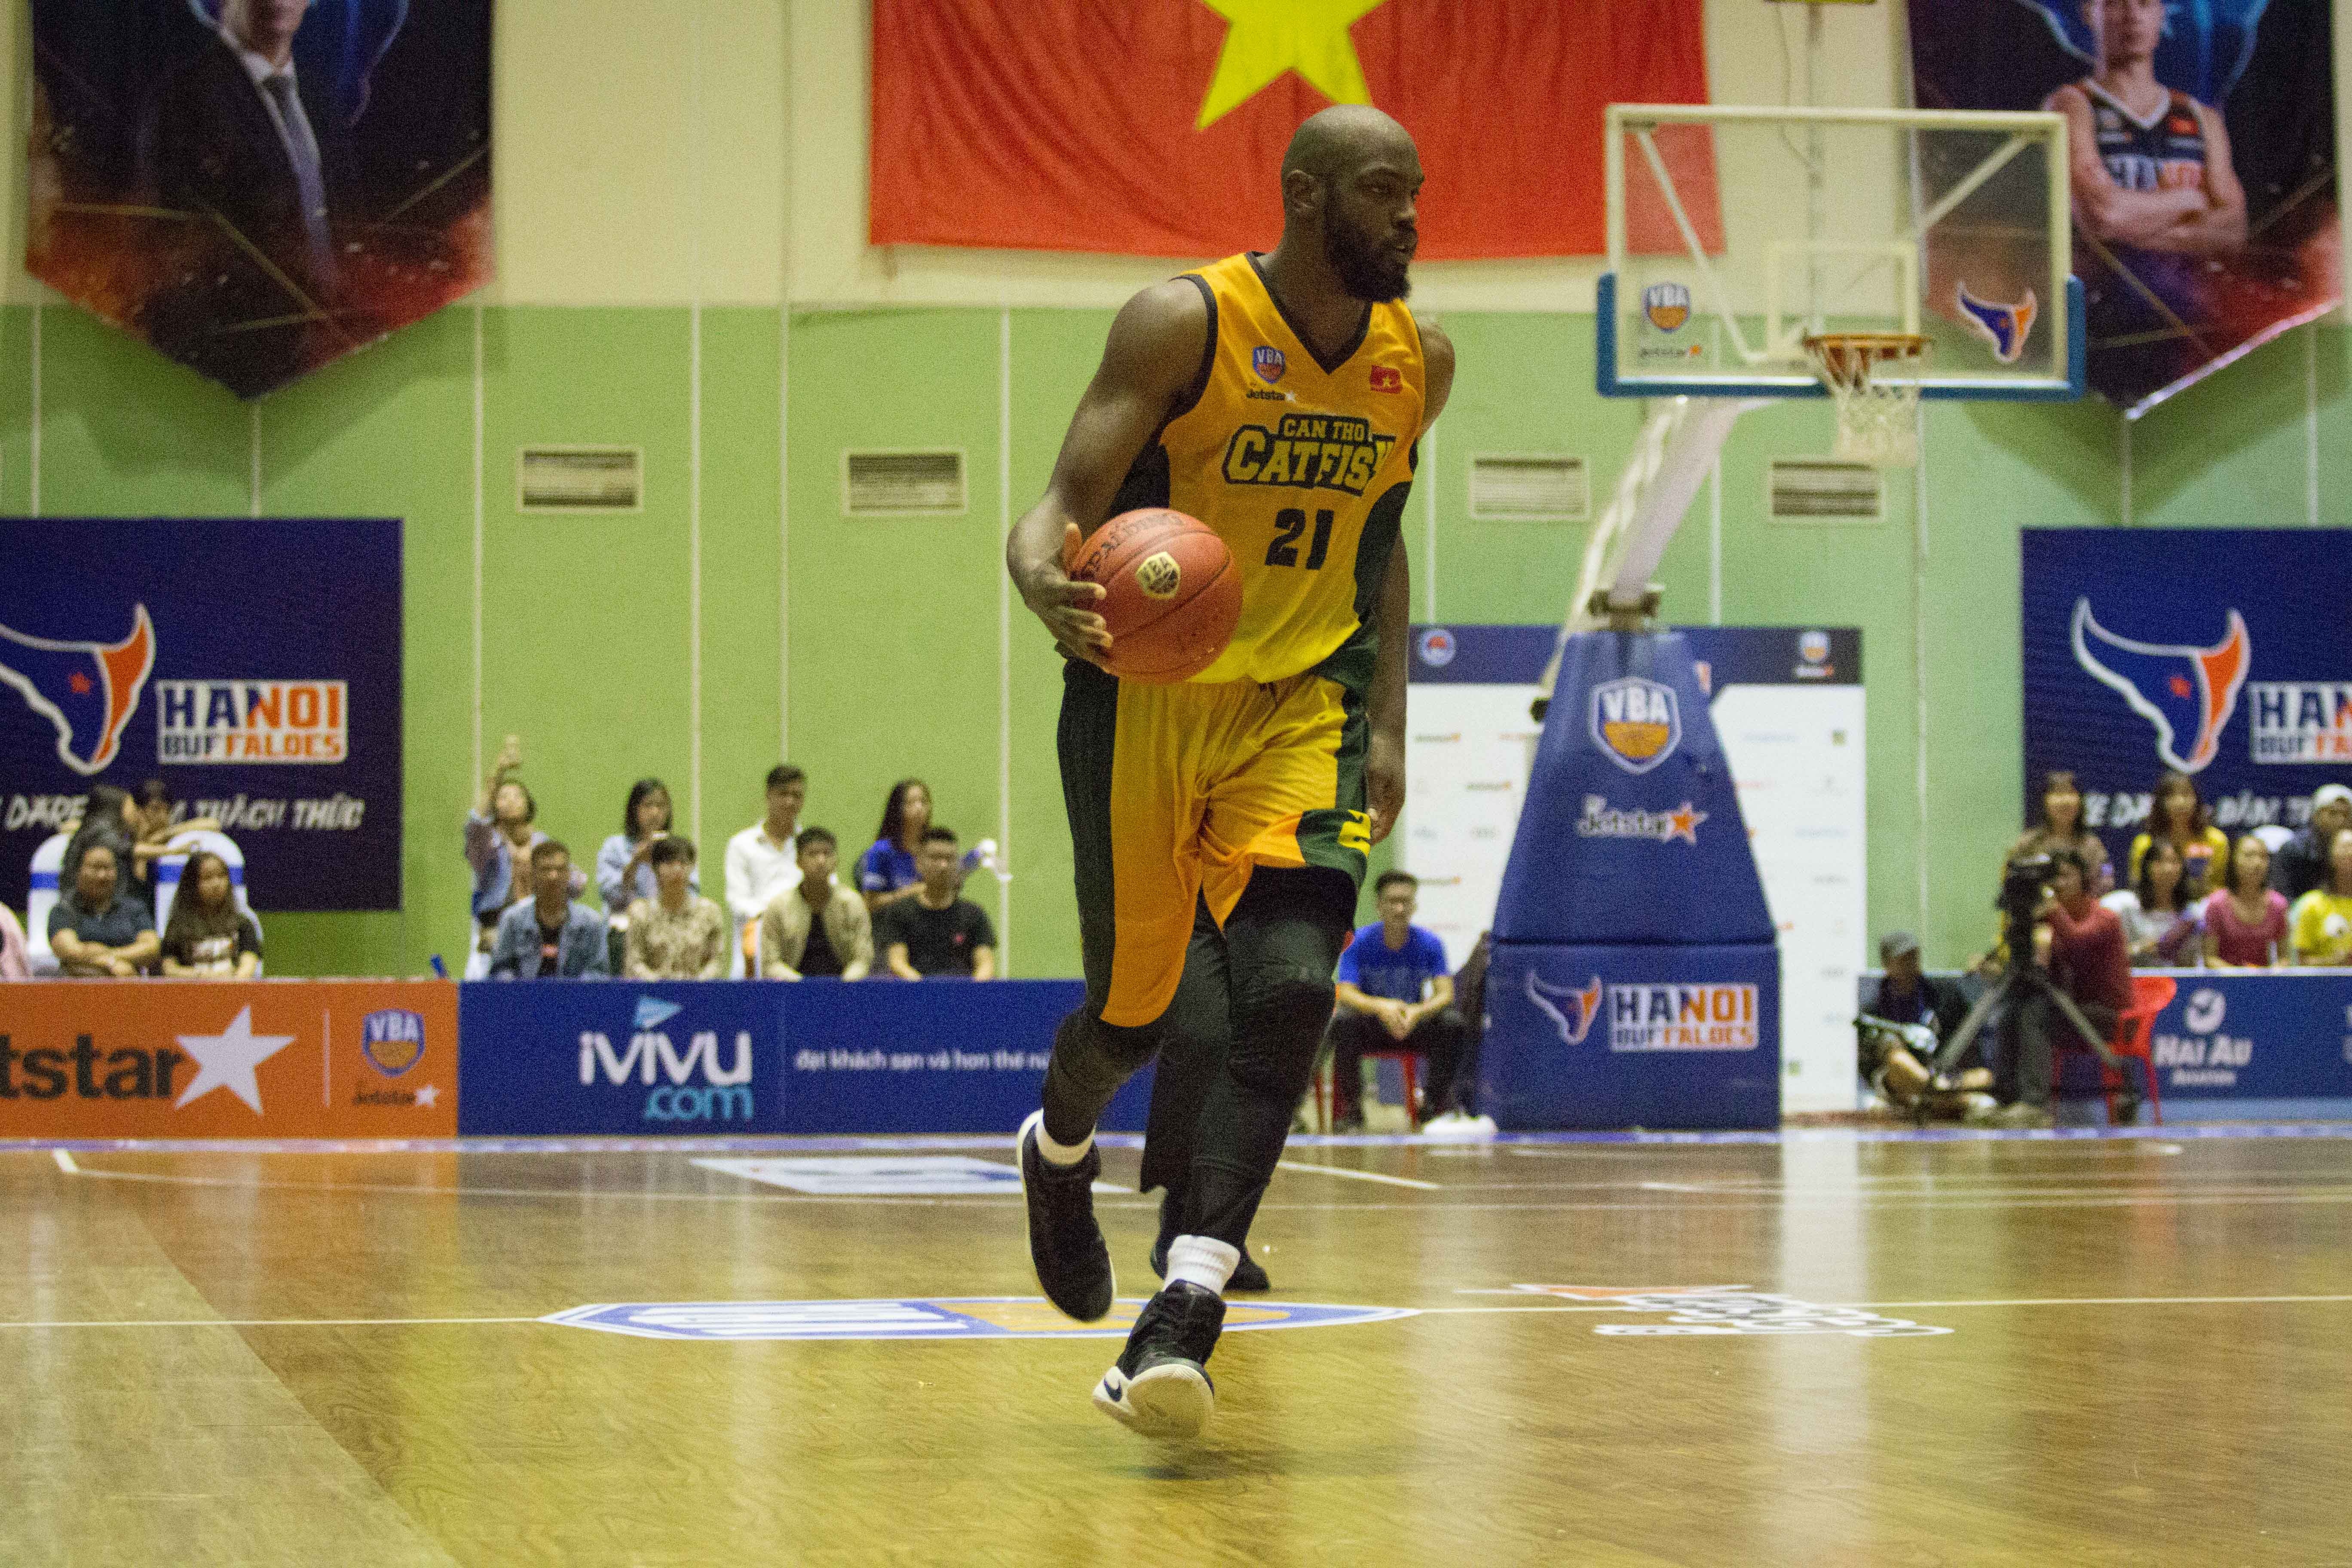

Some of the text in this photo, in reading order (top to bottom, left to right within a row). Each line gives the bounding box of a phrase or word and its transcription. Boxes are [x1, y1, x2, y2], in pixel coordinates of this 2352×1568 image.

[1257, 349, 1283, 365] VBA
[1283, 417, 1365, 443] CAN THO
[1265, 509, 1334, 570] 21
[164, 687, 340, 728] HANOI
[1603, 687, 1669, 723] VBA
[164, 733, 341, 756] BUFFALOES
[1616, 989, 1751, 1022] HANOI
[371, 1013, 420, 1042] VBA
